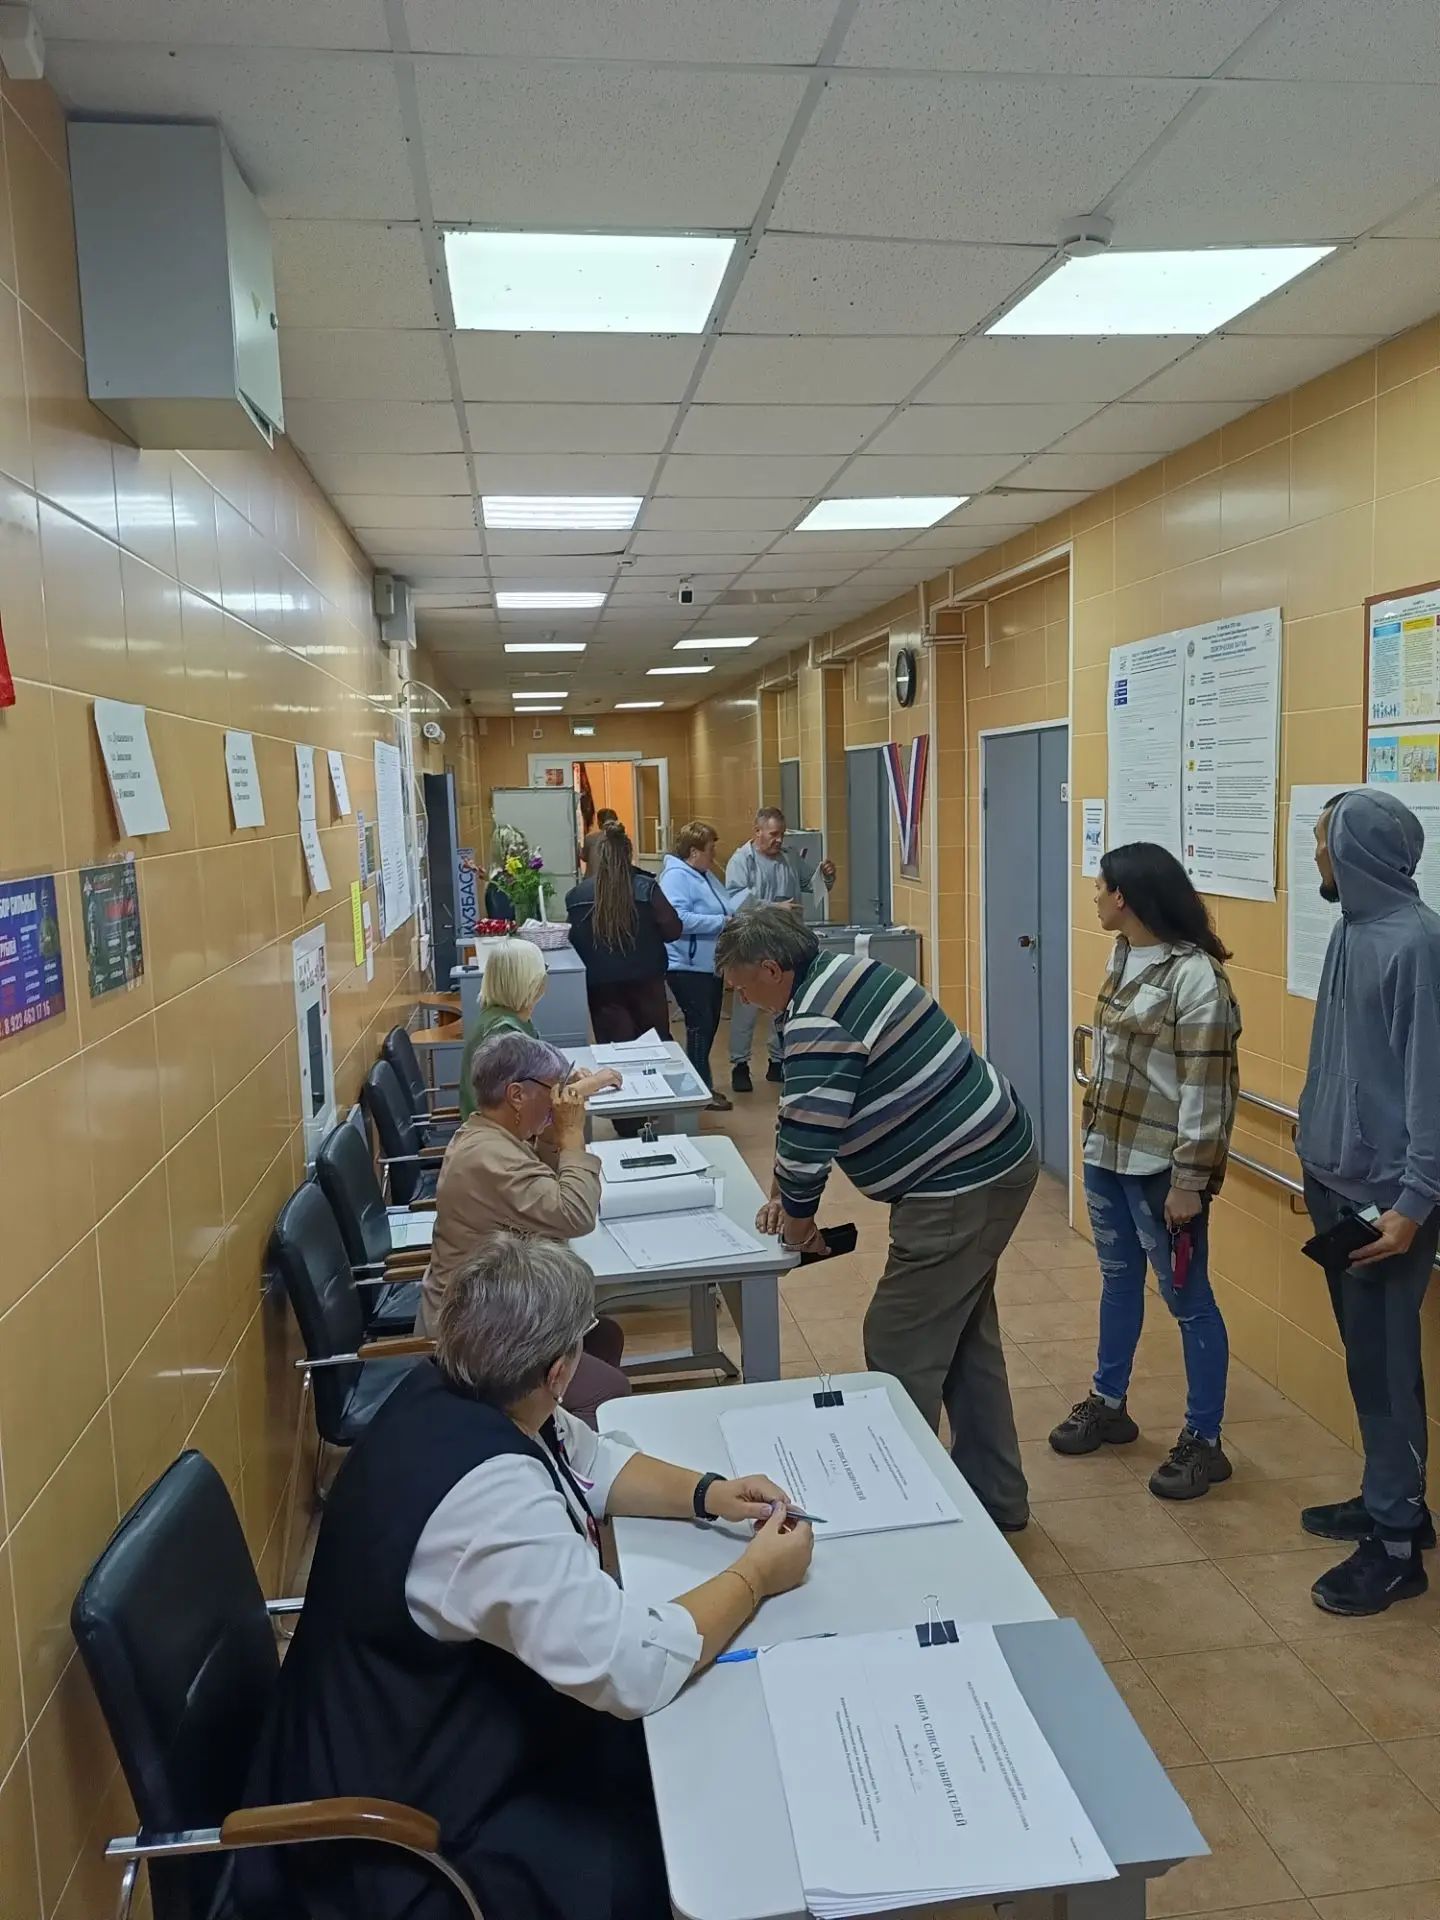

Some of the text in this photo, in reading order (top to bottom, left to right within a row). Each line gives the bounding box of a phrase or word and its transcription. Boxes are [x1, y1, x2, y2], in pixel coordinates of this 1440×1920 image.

[458, 862, 476, 938] КУЗБАСС
[913, 1693, 968, 1827] КНИГА СПИСКА ИЗБИРАТЕЛЕЙ
